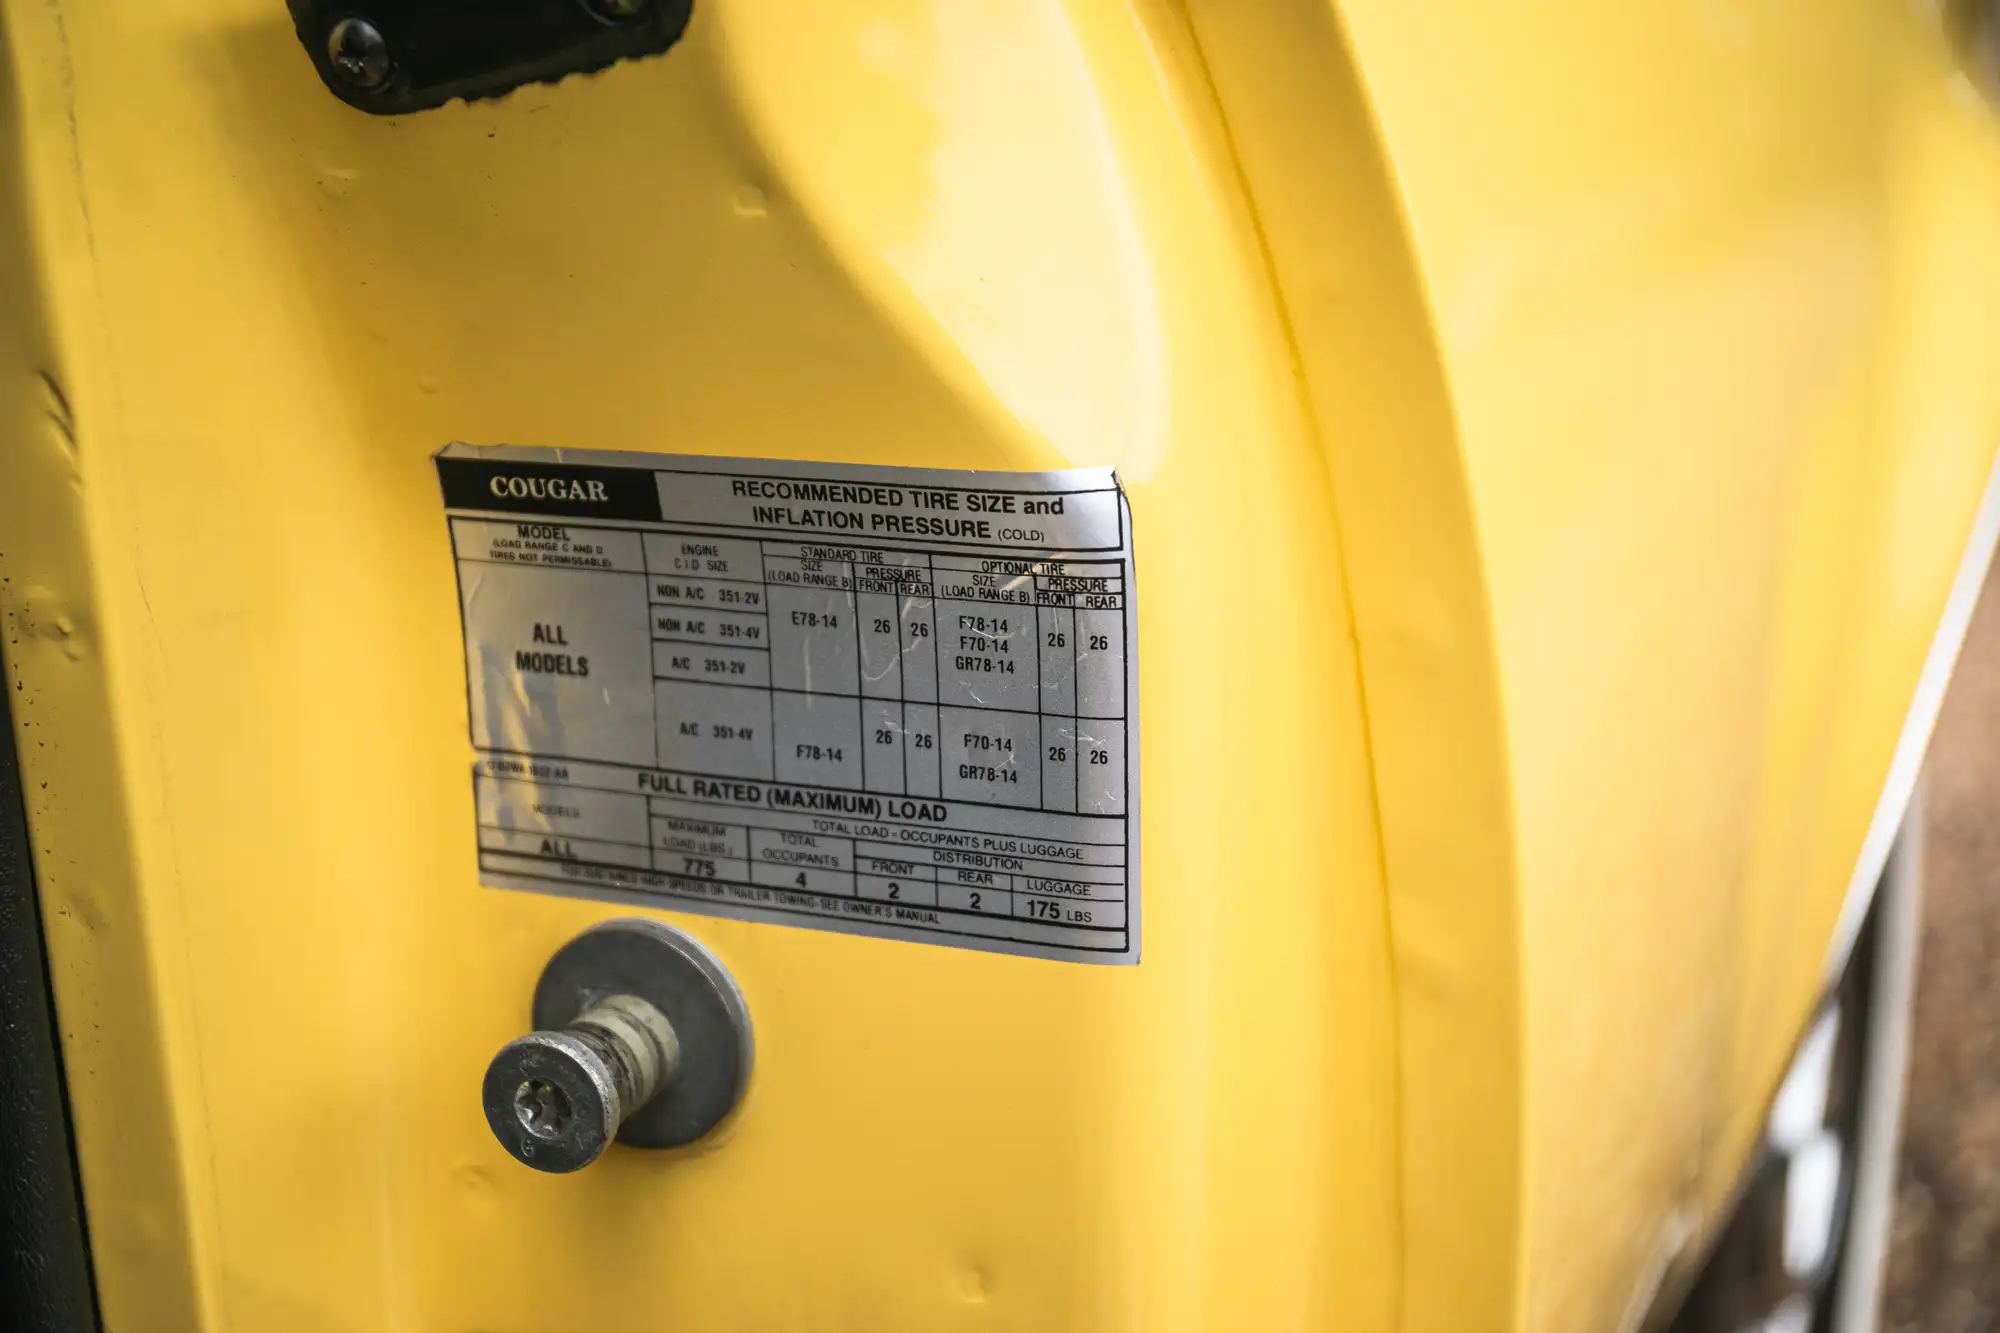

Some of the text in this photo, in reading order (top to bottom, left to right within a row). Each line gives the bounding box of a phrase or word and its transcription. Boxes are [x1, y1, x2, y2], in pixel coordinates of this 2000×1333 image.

[490, 476, 608, 501] COUGAR
[732, 480, 1064, 515] RECOMMENDED TIRE SIZE and
[753, 506, 1045, 543] INFLATION PRESSURE (COLD)
[517, 526, 571, 541] MODEL
[490, 550, 515, 560] TIRES
[518, 553, 538, 561] NOT
[525, 541, 558, 551] RANGE
[573, 544, 592, 554] AND
[681, 543, 719, 557] ENGINE
[801, 547, 884, 564] STANDARD TIRE
[707, 559, 729, 572] SIZE
[801, 560, 823, 572] SIZE
[982, 560, 1065, 575] OPTIONAL TIRE
[768, 569, 799, 583] (LOAD
[803, 573, 838, 588] RANGE
[866, 567, 921, 582] PRESSURE
[972, 574, 996, 586] SIZE
[657, 584, 680, 598] NON
[686, 586, 704, 600] A/C
[859, 580, 929, 595] FRONT REAR
[1048, 578, 1108, 592] PRESSURE
[941, 585, 1030, 602] (LOAD RANGE B)
[1037, 592, 1117, 608] FRONT REAR
[658, 618, 681, 632] NON
[686, 620, 705, 634] A/C
[792, 611, 837, 628] E78-14
[874, 619, 891, 634] 26
[959, 615, 1008, 633] F78-14
[533, 622, 568, 645] ALL
[910, 622, 928, 637] 26
[960, 636, 1009, 653] F70-14
[1047, 633, 1065, 648] 26
[1090, 635, 1108, 650] 26
[516, 651, 589, 677] MODELS
[672, 656, 690, 670] A/C
[955, 656, 1014, 674] GR78-14
[679, 722, 699, 736] A/C
[876, 729, 893, 745] 26
[915, 733, 933, 749] 26
[964, 734, 1012, 752] F70-14
[796, 744, 842, 762] F78-14
[1049, 747, 1066, 762] 26
[1090, 750, 1108, 765] 26
[959, 764, 1017, 784] GR78-14
[638, 772, 947, 822] FULL RATED (MAXIMUM) LOAD
[668, 820, 727, 836] MAXIMUM
[780, 832, 820, 848] TOTAL
[812, 819, 851, 834] TOTAL
[854, 824, 888, 838] LOAD
[900, 829, 980, 849] OCCUPANTS
[983, 838, 1016, 852] PLUS
[1020, 842, 1084, 860] LUGGAGE
[540, 838, 578, 859] ALL
[761, 848, 840, 867] OCCUPANTS
[933, 851, 1023, 871] DISTRIBUTION
[683, 858, 716, 877] 775
[872, 860, 914, 875] FRONT
[795, 871, 807, 888] 4
[957, 871, 993, 884] REAR
[887, 883, 900, 899] 2
[1027, 879, 1092, 896] LUGGAGE
[728, 885, 770, 901] TRAILER
[842, 901, 892, 919] OWNER'S
[896, 908, 941, 924] MANUAL
[969, 892, 981, 909] 2
[1027, 900, 1092, 923] 175 LBS
